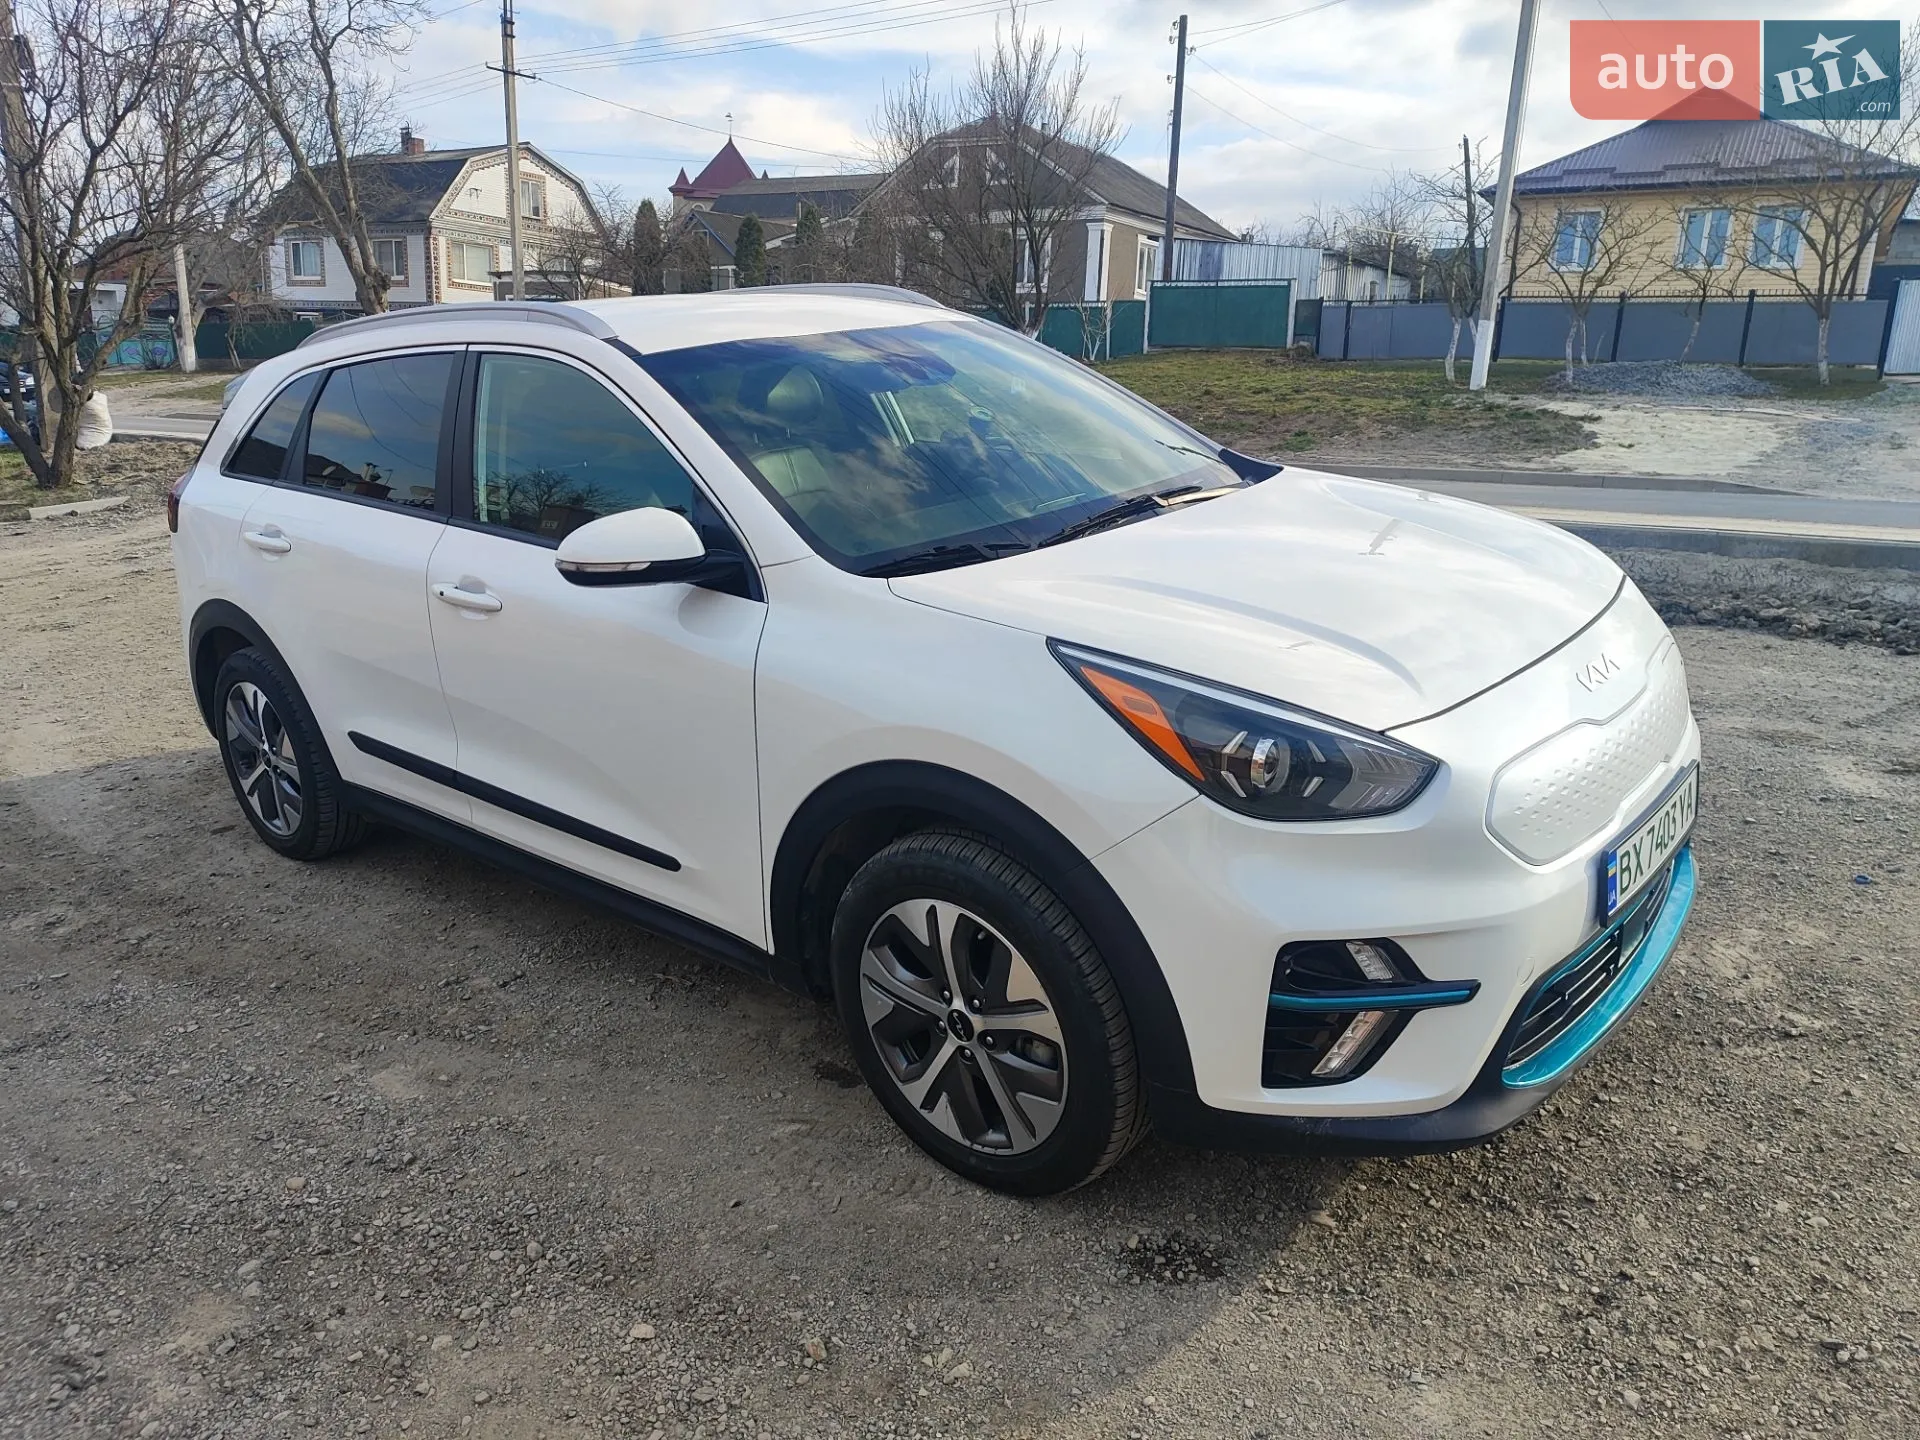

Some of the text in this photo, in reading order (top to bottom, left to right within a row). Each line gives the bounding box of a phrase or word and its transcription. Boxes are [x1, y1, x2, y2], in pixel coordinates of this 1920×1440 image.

[1620, 781, 1693, 896] BX 7403 YA
